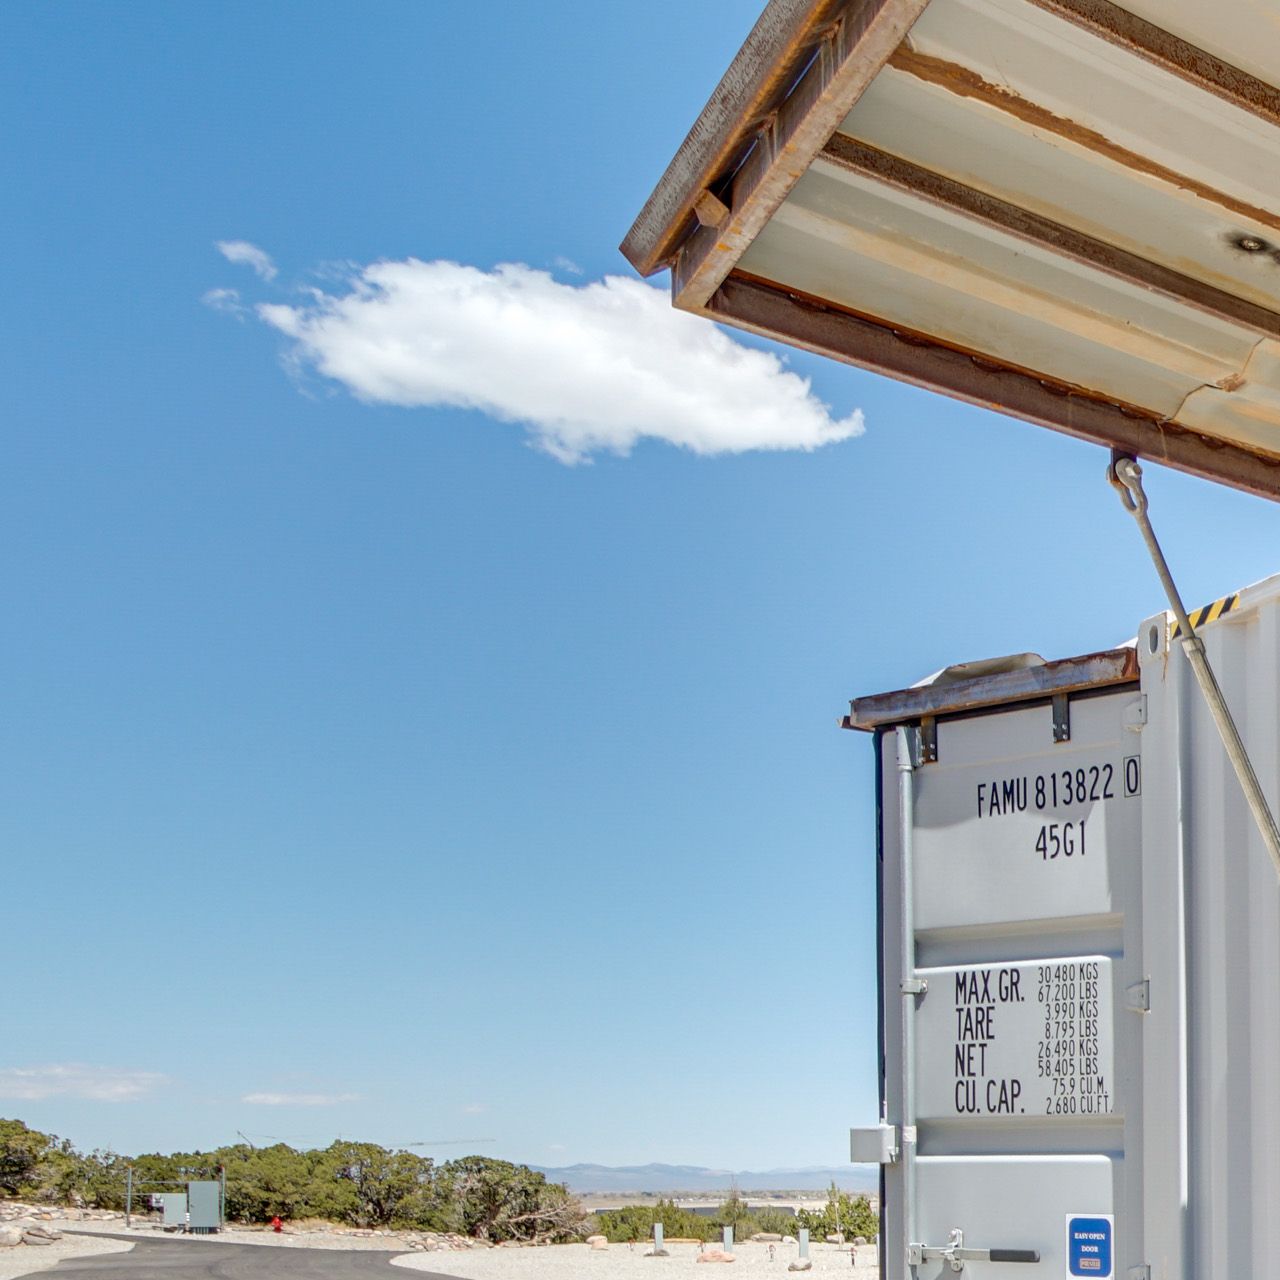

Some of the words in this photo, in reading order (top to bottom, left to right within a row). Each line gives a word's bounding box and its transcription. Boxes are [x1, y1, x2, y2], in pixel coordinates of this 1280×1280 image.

[977, 776, 1028, 818] FAMU
[1034, 763, 1114, 811] 813822
[1034, 820, 1087, 861] 45G1
[1038, 964, 1075, 984] 30.480
[1079, 962, 1099, 981] KGS
[1038, 983, 1075, 1003] 67.200
[1079, 981, 1098, 1000] LBS
[955, 1006, 996, 1042] TARE
[1045, 1002, 1075, 1021] 3.990
[1079, 1000, 1099, 1019] KGS
[1045, 1021, 1075, 1040] 8.795
[1079, 1019, 1098, 1038] LBS
[955, 1043, 987, 1078] NET
[1038, 1039, 1075, 1059] 26.490
[1079, 1038, 1099, 1057] KGS
[1038, 1058, 1075, 1077] 58.405
[1079, 1057, 1098, 1076] LBS
[986, 1079, 1025, 1114] CAP.
[1053, 1077, 1075, 1096] 75.9
[1046, 1096, 1076, 1115] 2.680
[1074, 1232, 1089, 1240] EASY
[1089, 1232, 1105, 1241] OPEN
[1081, 1245, 1099, 1253] DOOR
